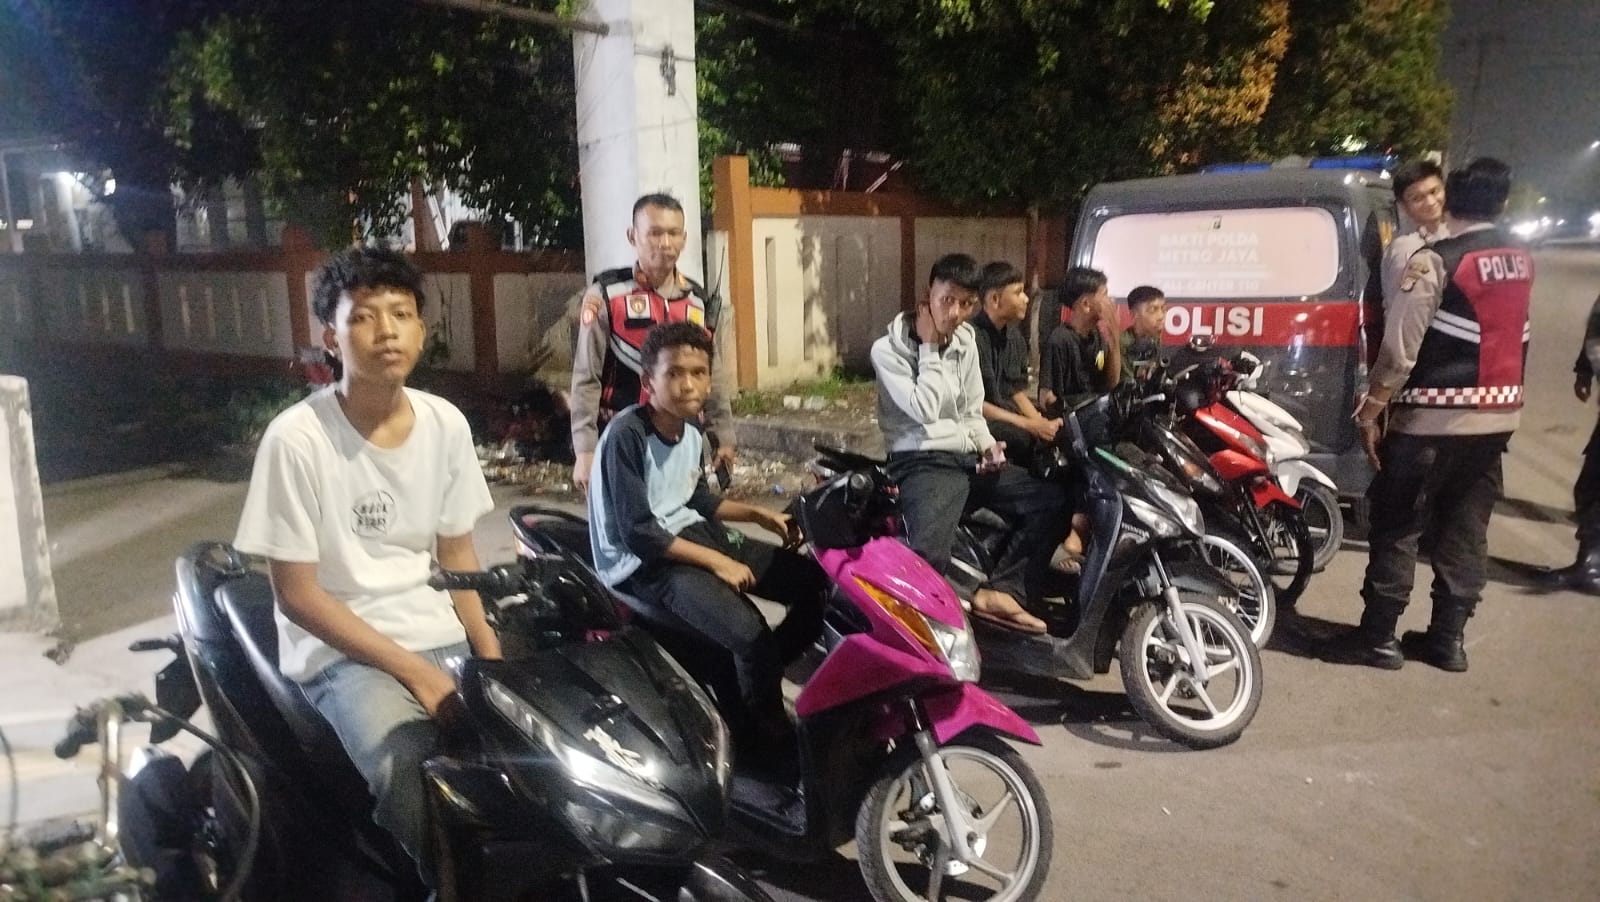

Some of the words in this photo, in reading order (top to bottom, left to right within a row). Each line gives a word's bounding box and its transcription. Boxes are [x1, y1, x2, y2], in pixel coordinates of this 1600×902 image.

[1159, 233, 1204, 248] BAKTI
[1208, 232, 1259, 247] POLDA
[1158, 249, 1212, 264] METRO
[1217, 248, 1259, 263] JAYA
[1164, 306, 1264, 336] OLISI
